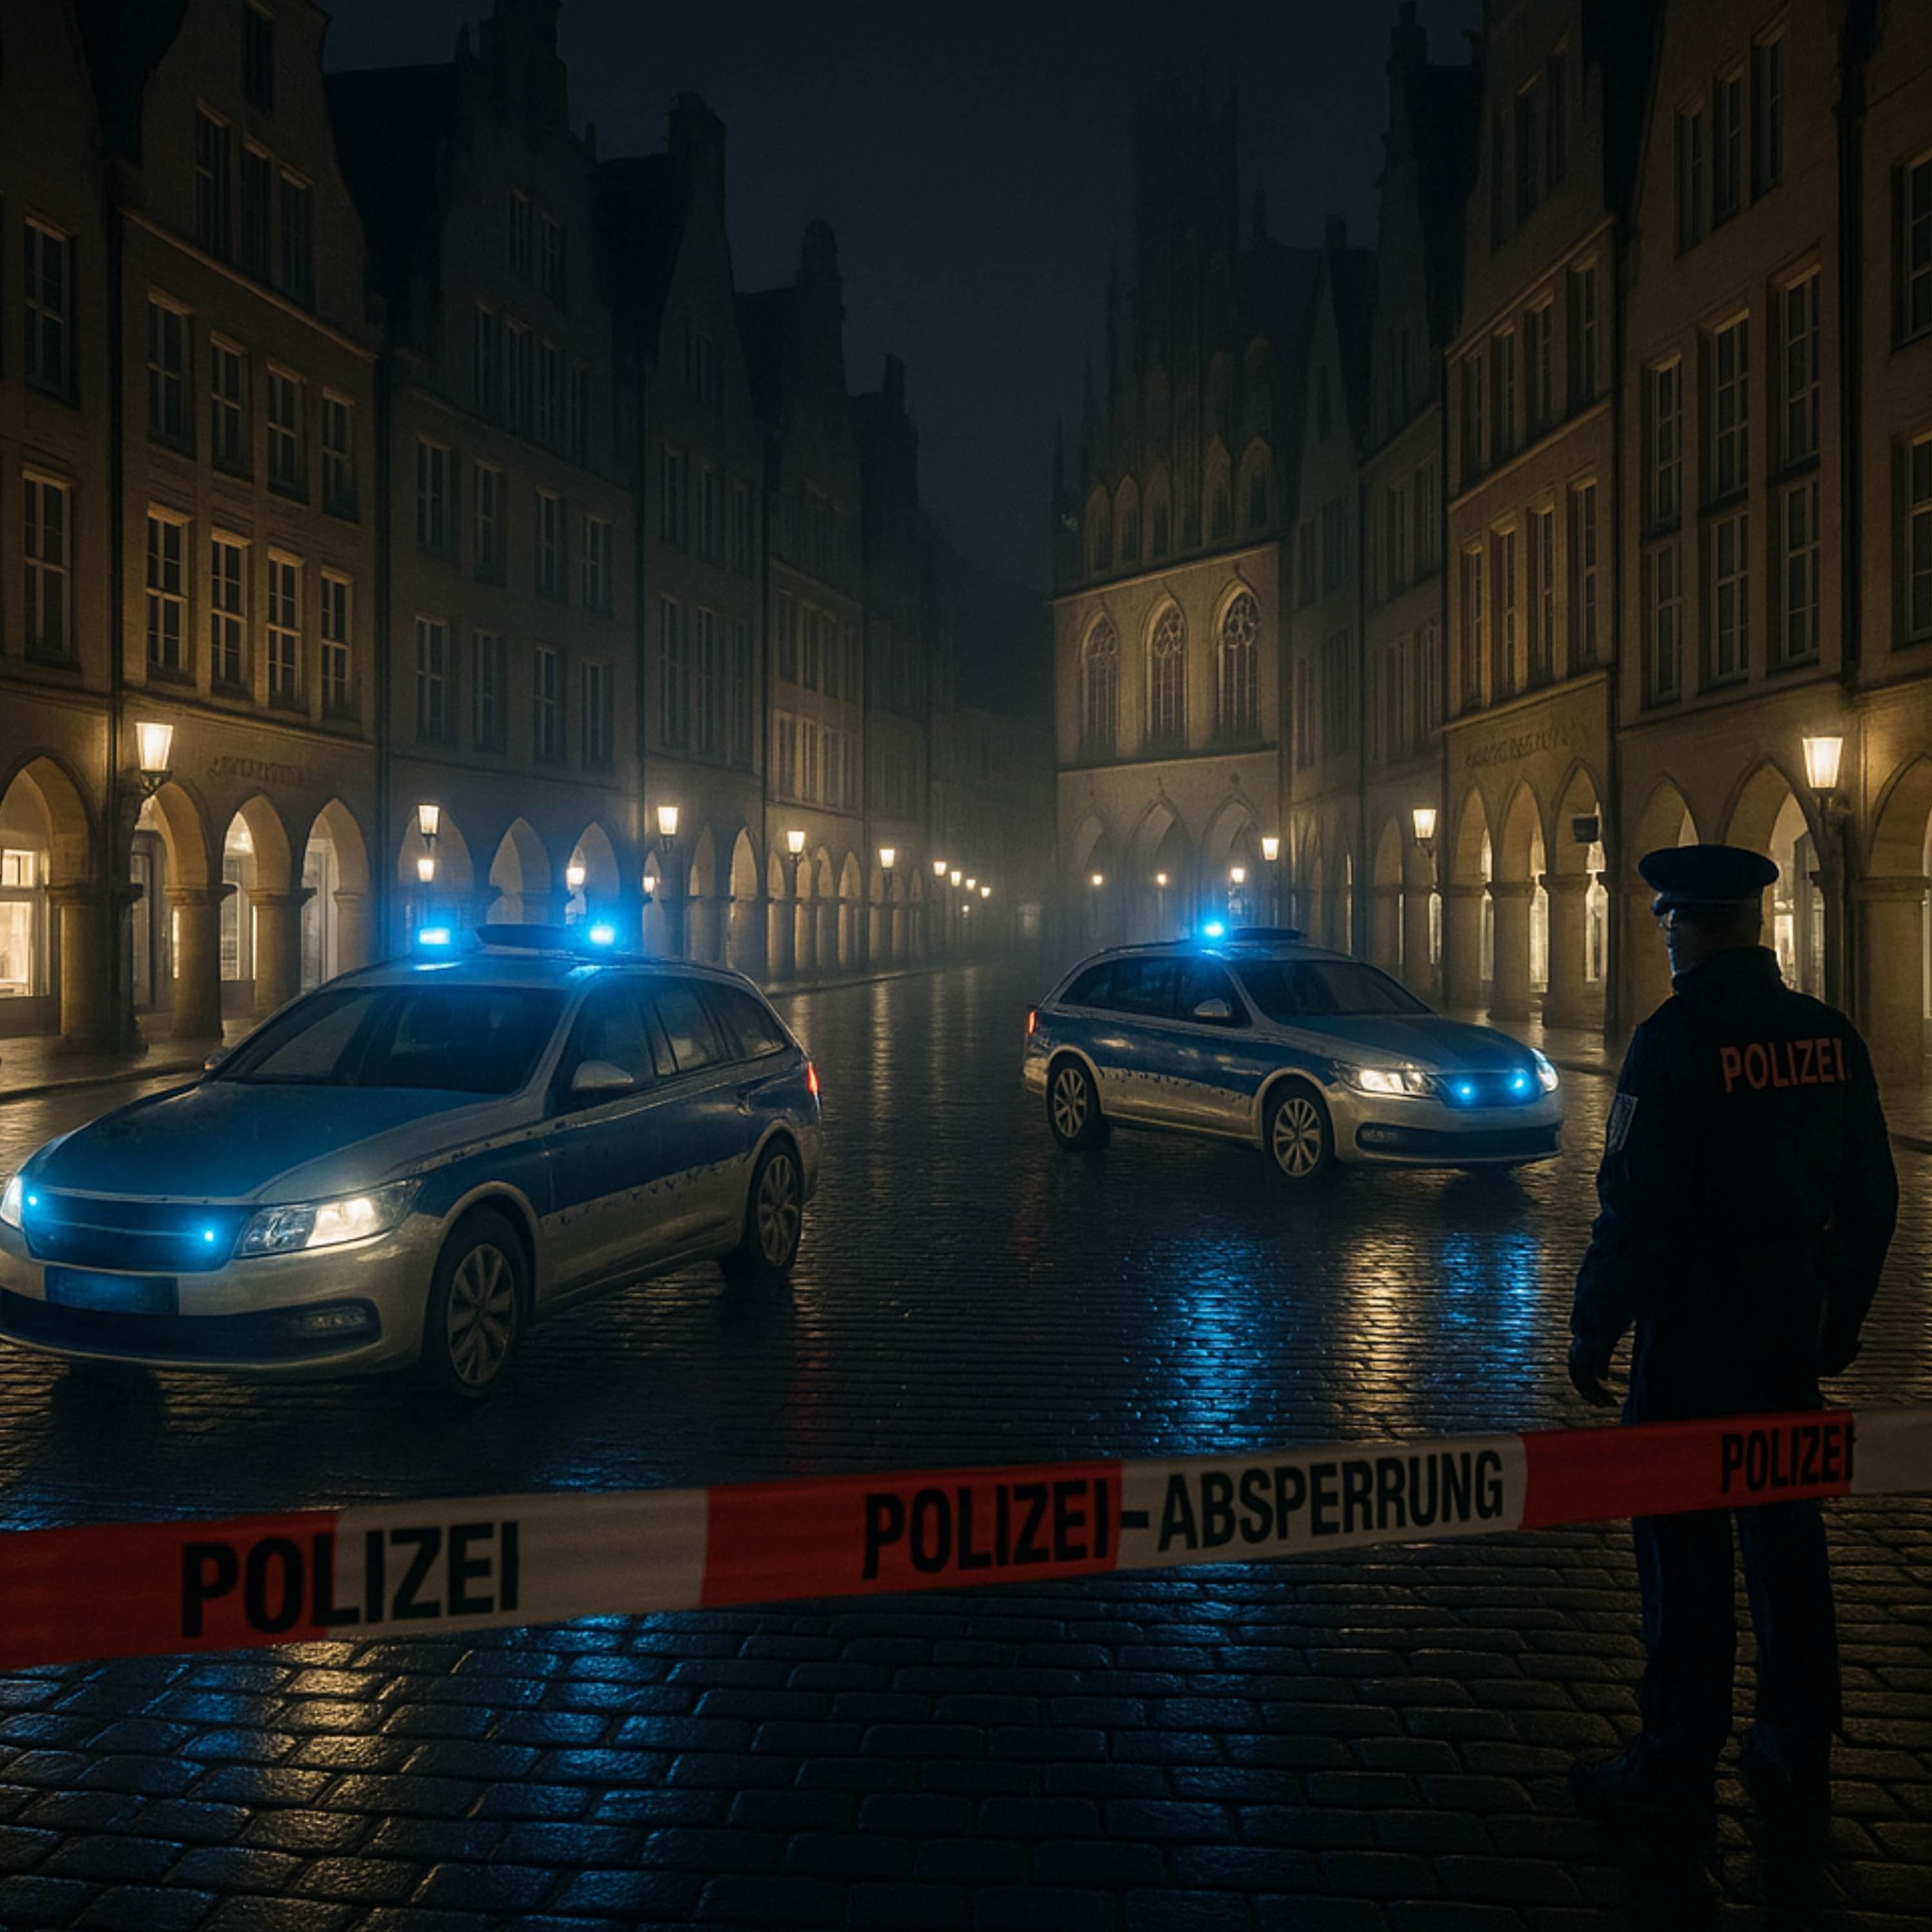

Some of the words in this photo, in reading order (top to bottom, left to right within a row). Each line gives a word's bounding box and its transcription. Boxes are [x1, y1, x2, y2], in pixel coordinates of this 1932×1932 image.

[1719, 1037, 1846, 1094] POLIZEI
[182, 1521, 518, 1636] POLIZEI
[862, 1451, 1502, 1579] POLIZEI-ABSPERRUNG
[1721, 1425, 1853, 1494] POLIZEI
